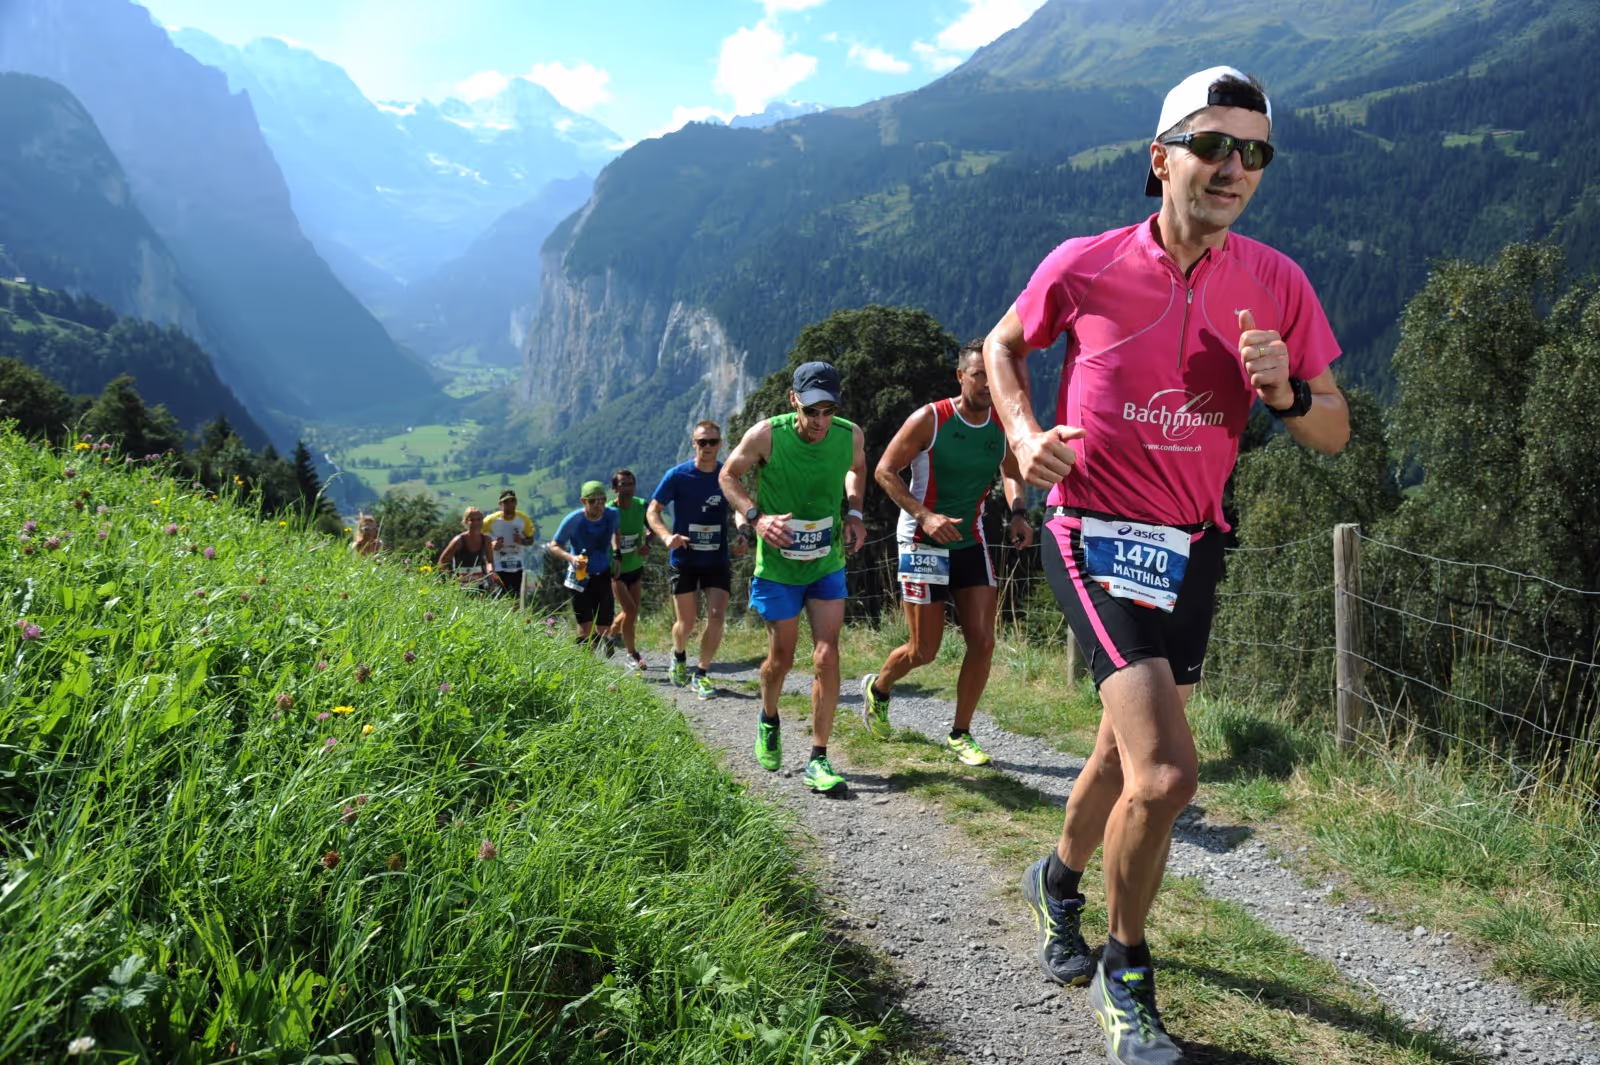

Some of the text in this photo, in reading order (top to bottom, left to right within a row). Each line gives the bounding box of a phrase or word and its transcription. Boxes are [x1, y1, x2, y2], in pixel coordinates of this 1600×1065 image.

[1122, 402, 1224, 427] Bachmann
[794, 531, 823, 543] 1438
[1133, 529, 1166, 542] asics
[909, 554, 938, 567] 1349
[1114, 540, 1169, 573] 1470
[1113, 562, 1170, 588] MATTHIAS
